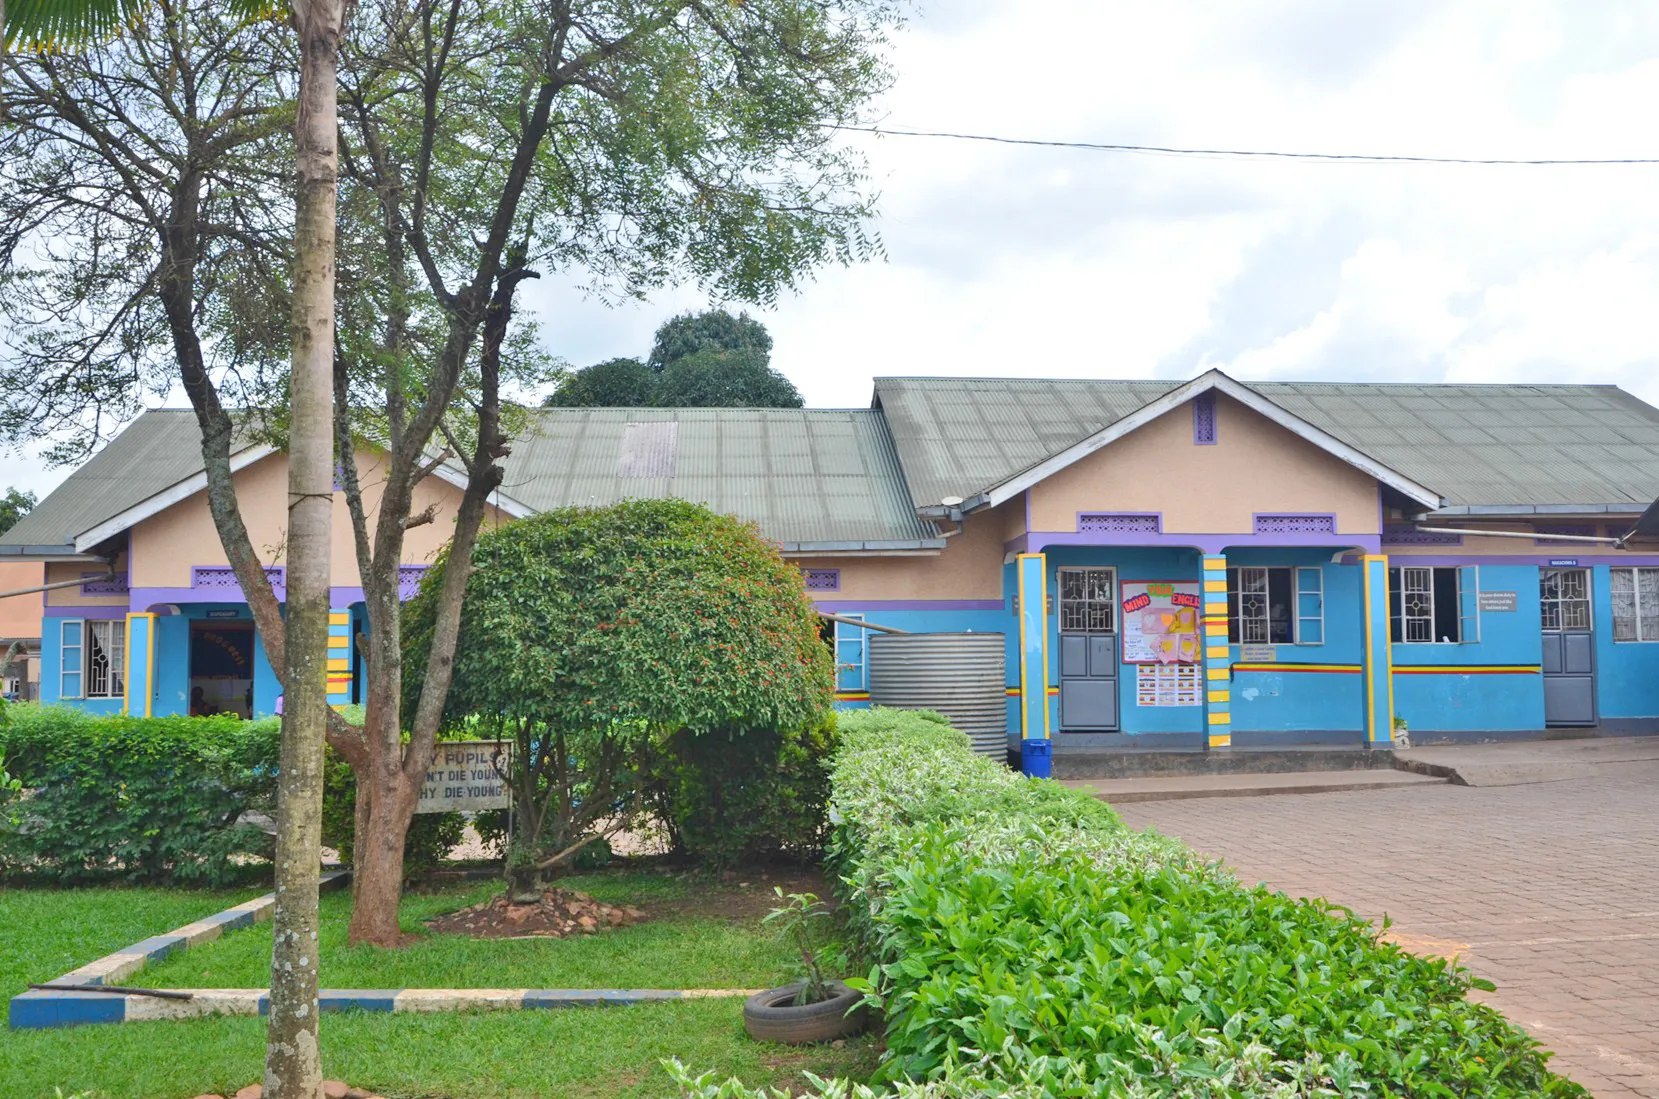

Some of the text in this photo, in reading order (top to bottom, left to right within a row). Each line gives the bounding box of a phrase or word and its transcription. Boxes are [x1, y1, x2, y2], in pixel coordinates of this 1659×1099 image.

[1123, 584, 1200, 613] MIND YOUR ENGLI
[425, 768, 504, 781] N'T DIE YOUN
[419, 787, 436, 799] HY
[445, 786, 463, 798] DIE
